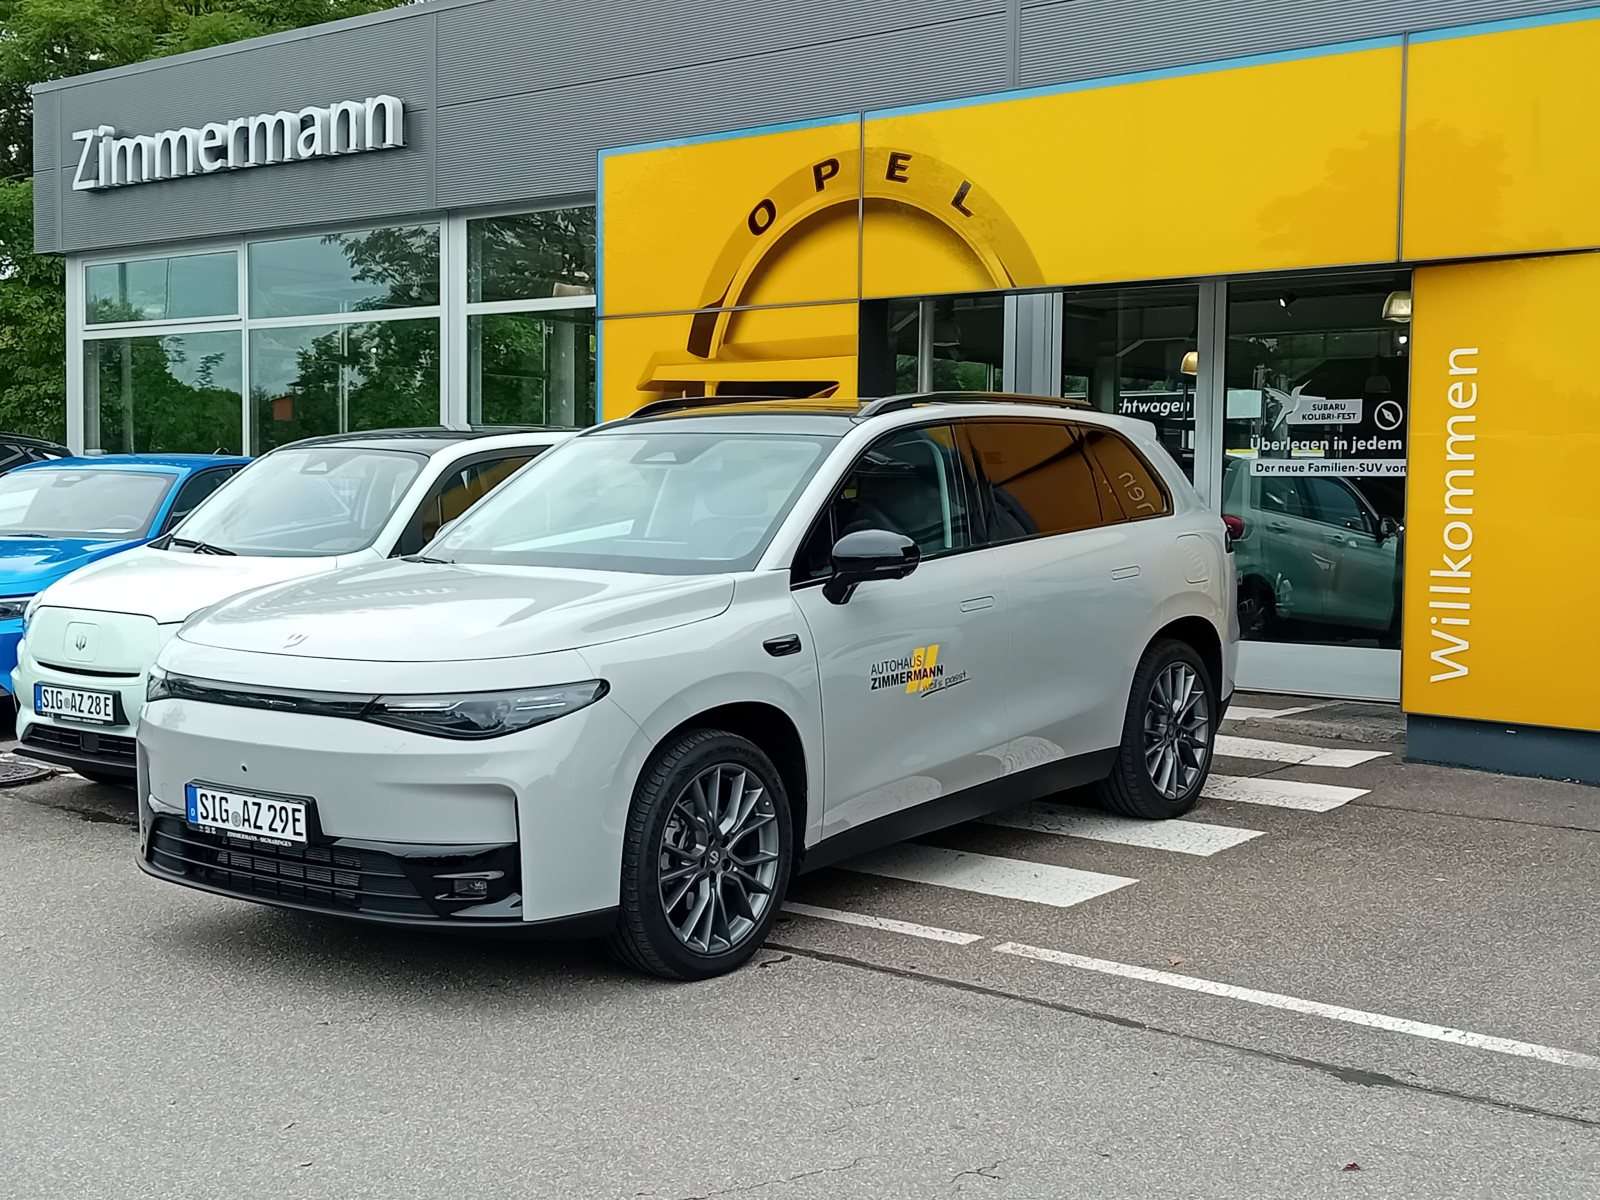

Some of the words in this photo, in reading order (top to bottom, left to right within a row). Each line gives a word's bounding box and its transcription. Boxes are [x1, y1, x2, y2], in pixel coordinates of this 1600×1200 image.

[72, 94, 405, 190] Zimmermann
[747, 151, 975, 236] OPEL
[1302, 412, 1357, 420] KOLIBRI-FEST
[1312, 403, 1346, 411] SUBARU
[1250, 434, 1329, 452] Überlegen
[1333, 436, 1348, 450] in
[1351, 435, 1402, 454] jedem
[1256, 463, 1275, 473] Der
[1278, 464, 1305, 473] neue
[1308, 462, 1382, 473] Familien-SUV
[1385, 465, 1407, 473] von
[1430, 347, 1479, 683] Willkommen
[870, 655, 922, 676] AUTOHAUS
[870, 664, 944, 691] ZIMMERMANN
[43, 689, 63, 709] SIG
[70, 693, 85, 713] AZ
[199, 793, 230, 823] SIG
[242, 800, 263, 830] AZ
